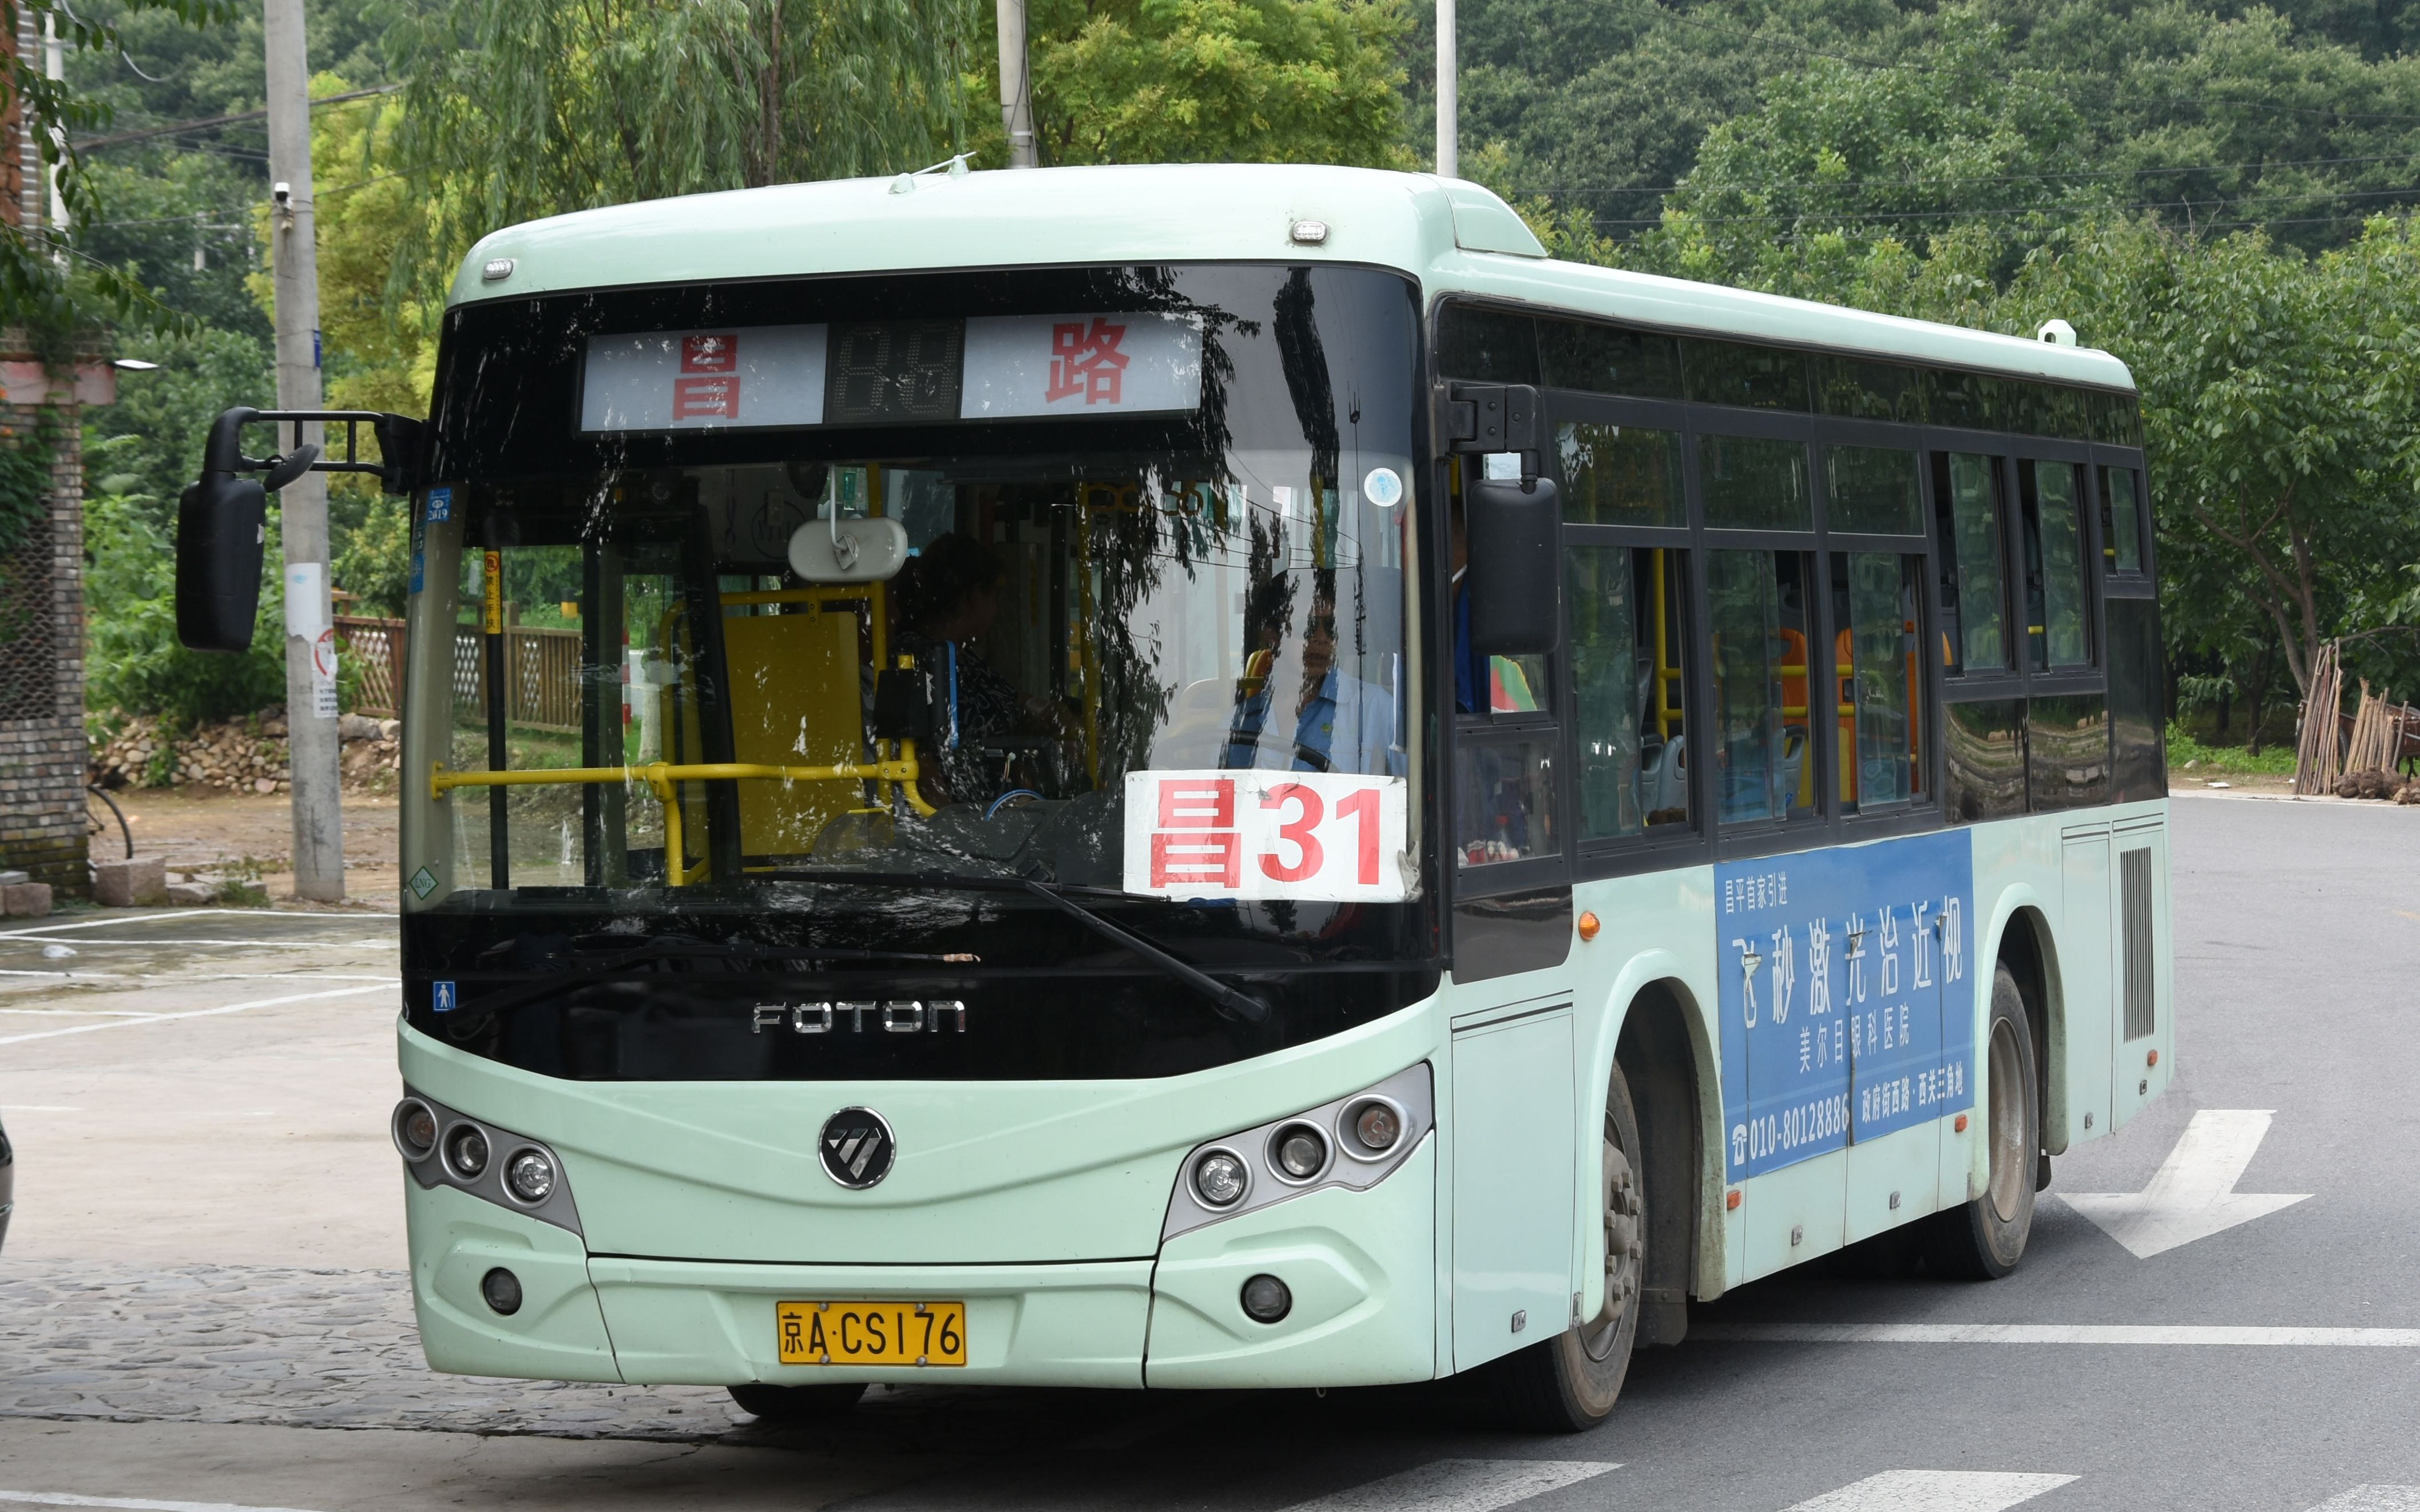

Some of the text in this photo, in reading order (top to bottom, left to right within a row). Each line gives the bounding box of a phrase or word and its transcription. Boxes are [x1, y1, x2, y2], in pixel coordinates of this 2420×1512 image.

[673, 317, 1130, 422] 昌 路
[428, 509, 448, 520] 2019
[486, 576, 495, 629] 禁止手扶
[1150, 779, 1380, 888] 昌31
[415, 878, 431, 888] LNG
[1725, 871, 1788, 914] 昌平首家引进
[752, 1000, 966, 1033] FOTON
[1800, 1002, 1909, 1074] 美尔目眼科医院
[1750, 1092, 1850, 1160] 010-80128886
